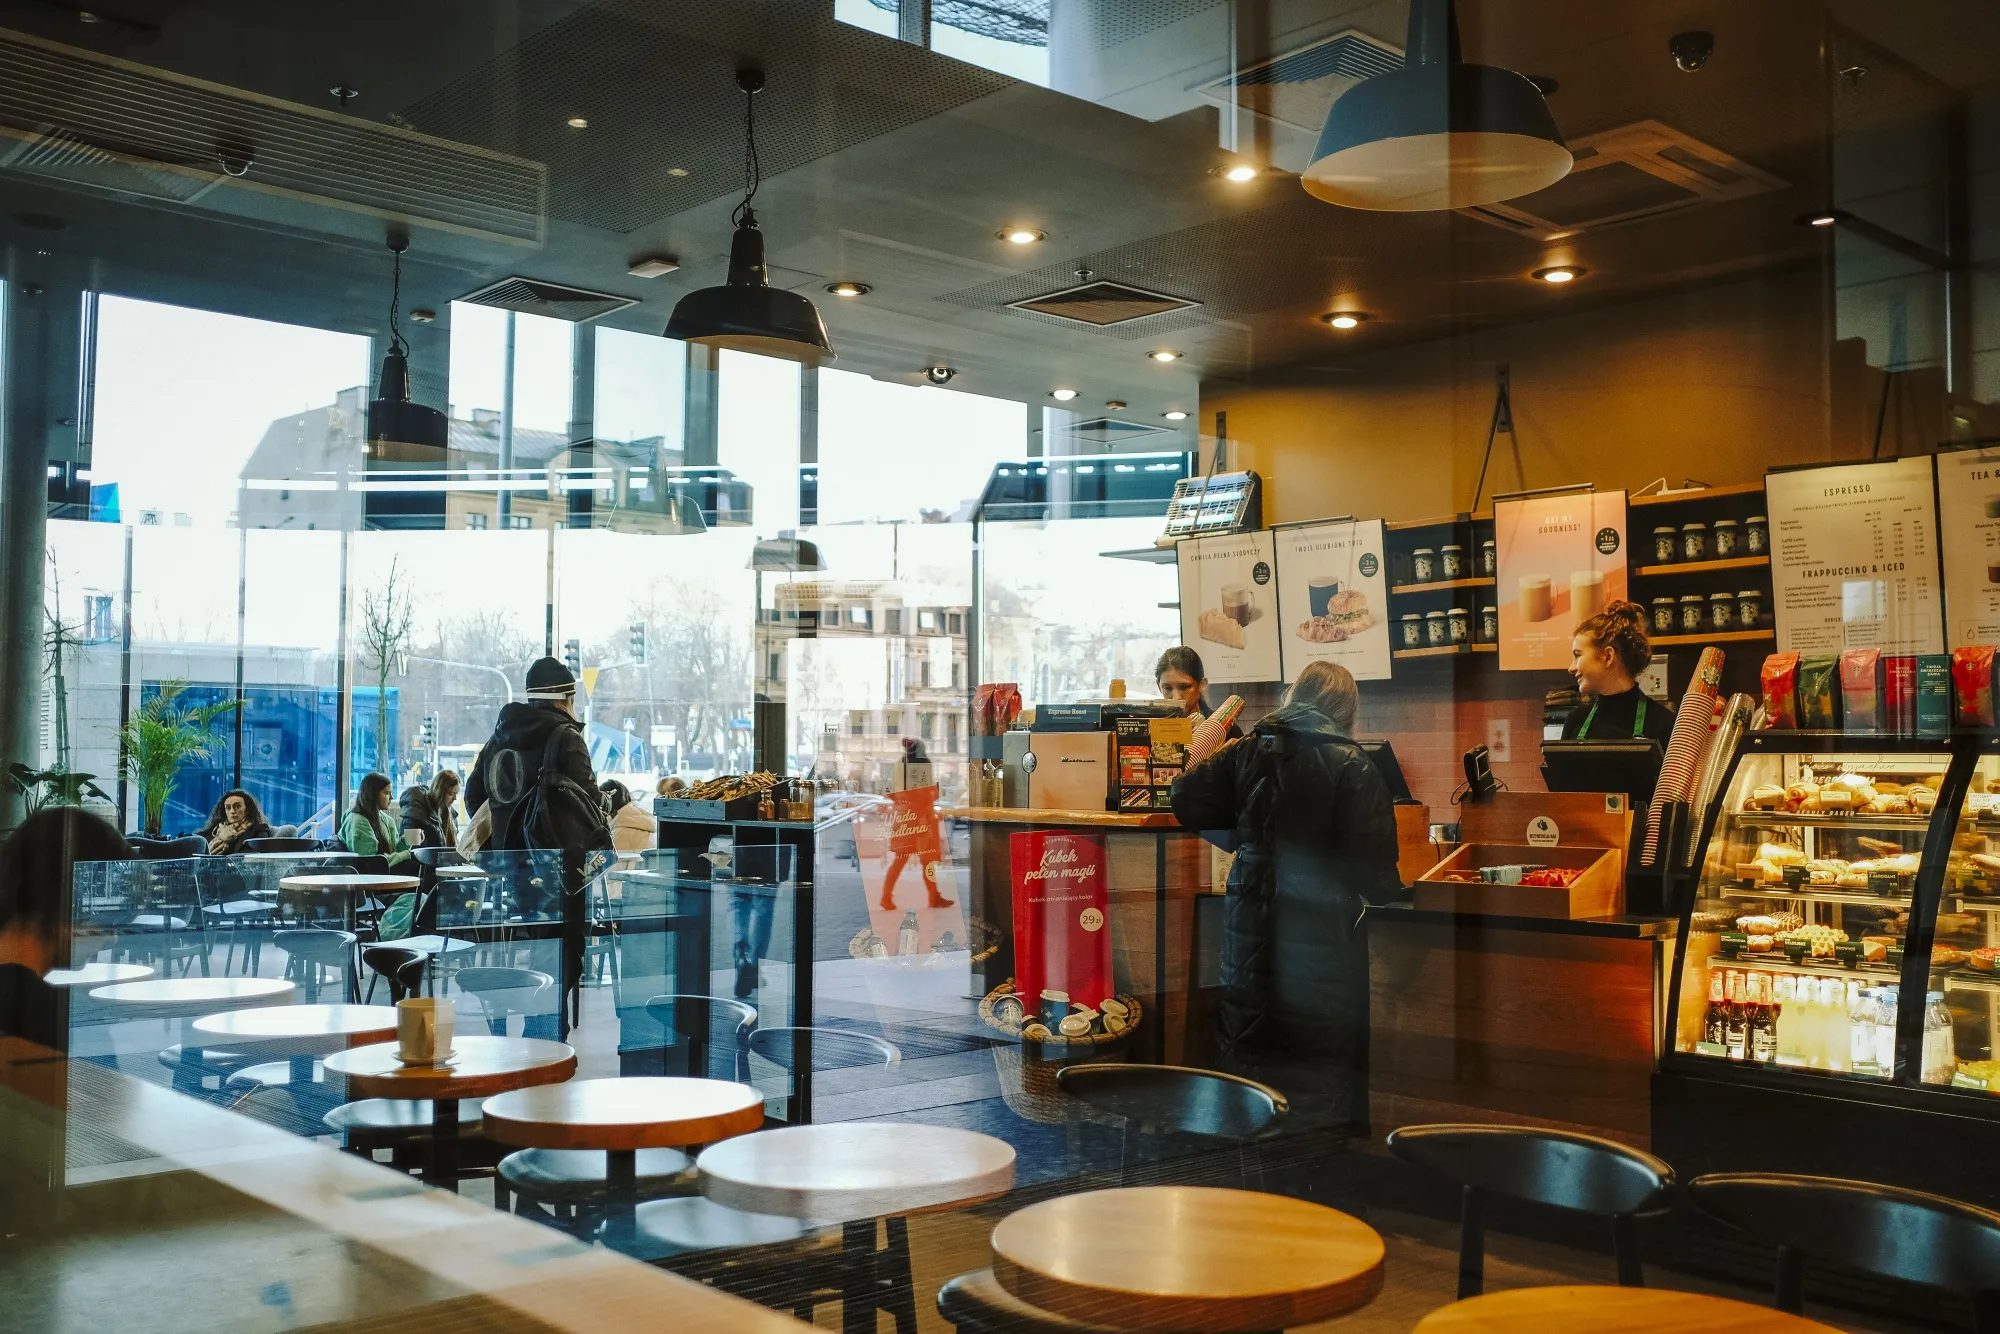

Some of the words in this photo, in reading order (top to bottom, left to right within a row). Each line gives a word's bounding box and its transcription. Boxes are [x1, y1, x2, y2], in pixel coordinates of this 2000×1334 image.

[1971, 471, 1989, 481] TEA
[1824, 484, 1871, 497] ESPRESSO
[1563, 515, 1573, 523] MY
[1539, 524, 1581, 534] GOODNESS!
[1316, 541, 1346, 551] ULUBIONE
[1802, 566, 1868, 578] FRAPPUCCINO
[1872, 564, 1878, 573] &
[1883, 563, 1905, 572] ICED
[1048, 708, 1071, 716] Espresso
[881, 808, 918, 827] Woda
[1039, 848, 1078, 867] Kubek
[1024, 865, 1059, 885] pełen
[1060, 864, 1096, 884] magii
[1082, 915, 1095, 925] 29
